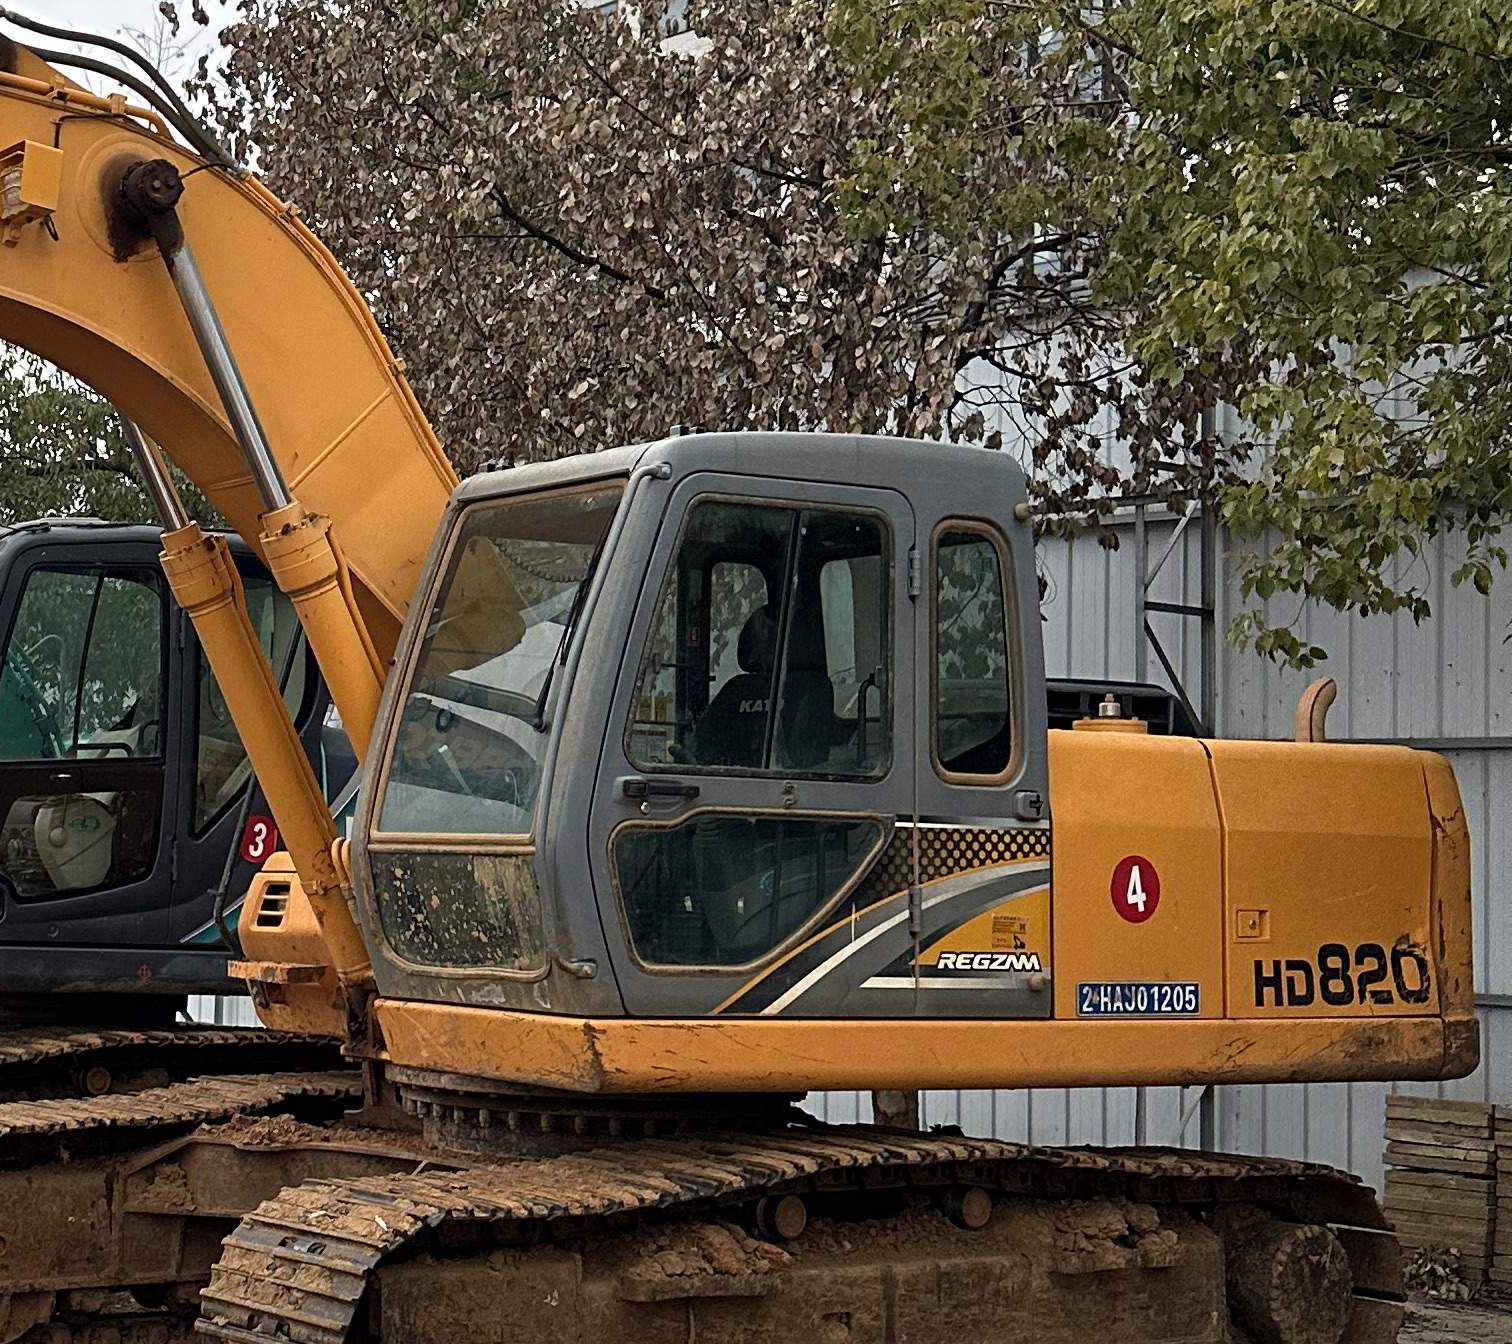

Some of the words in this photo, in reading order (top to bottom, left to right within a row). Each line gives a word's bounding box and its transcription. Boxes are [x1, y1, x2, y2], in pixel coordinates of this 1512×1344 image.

[248, 822, 267, 857] 3
[1126, 864, 1147, 913] 4
[1253, 942, 1431, 1007] HD820
